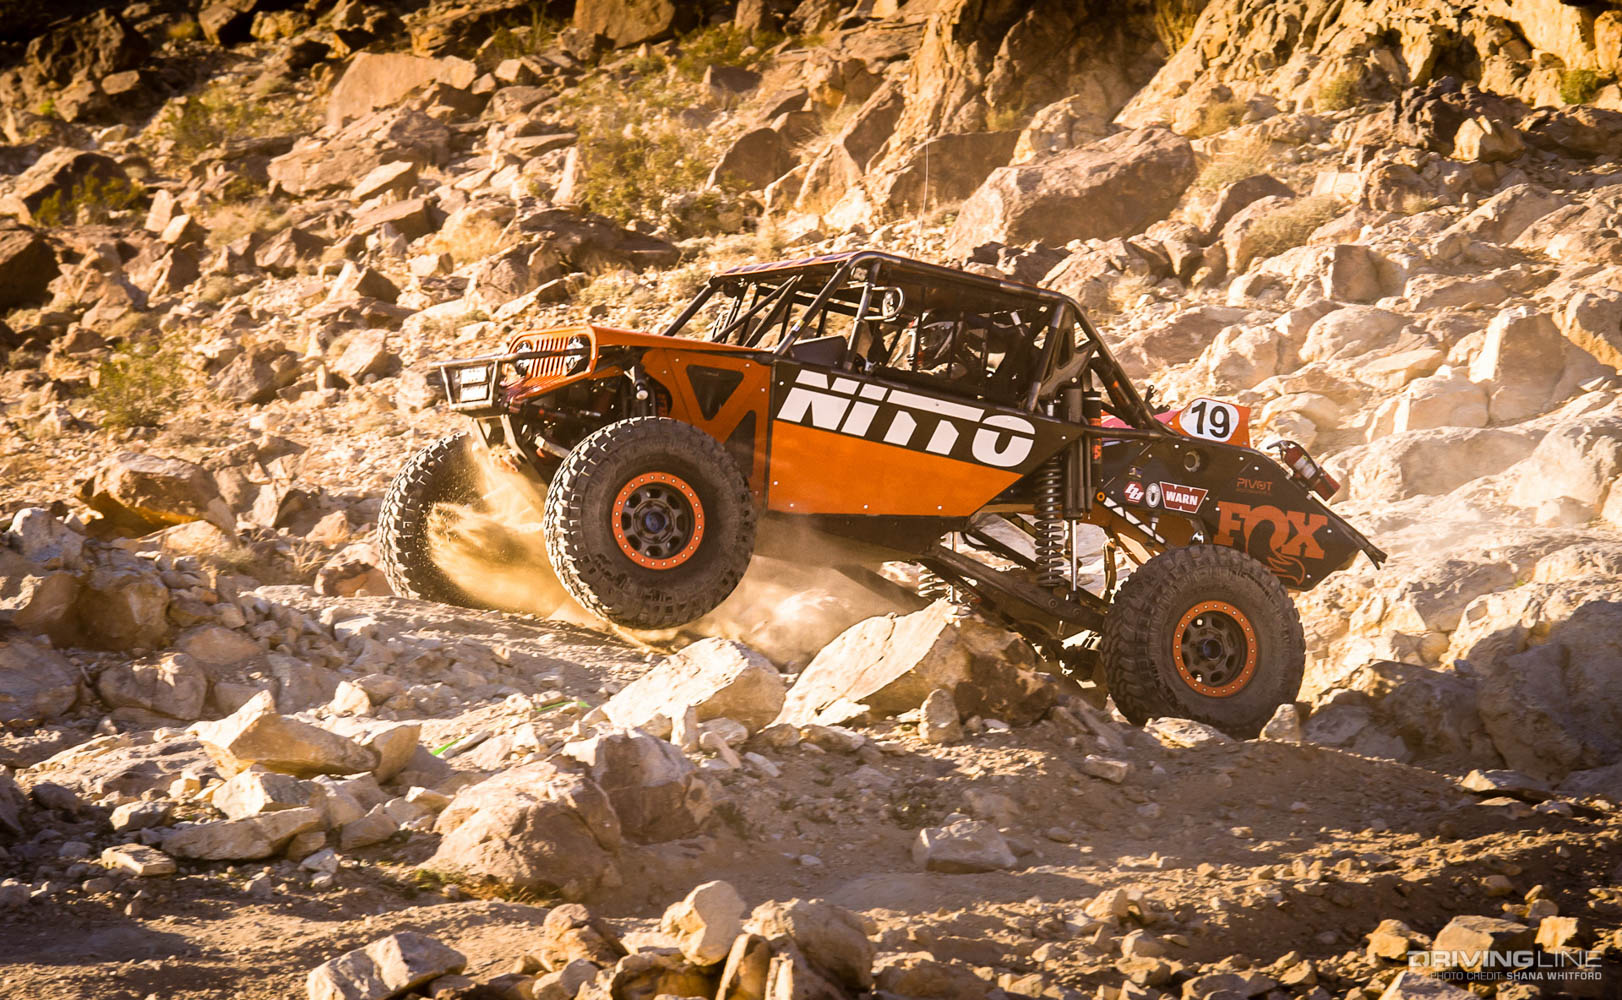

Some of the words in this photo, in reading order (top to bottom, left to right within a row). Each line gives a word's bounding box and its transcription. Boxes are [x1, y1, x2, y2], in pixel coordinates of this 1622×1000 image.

[776, 369, 1034, 467] NITTO
[1191, 401, 1230, 438] 19
[1166, 490, 1198, 506] WARN
[1236, 477, 1273, 491] PIVOT
[1213, 501, 1328, 560] FOX
